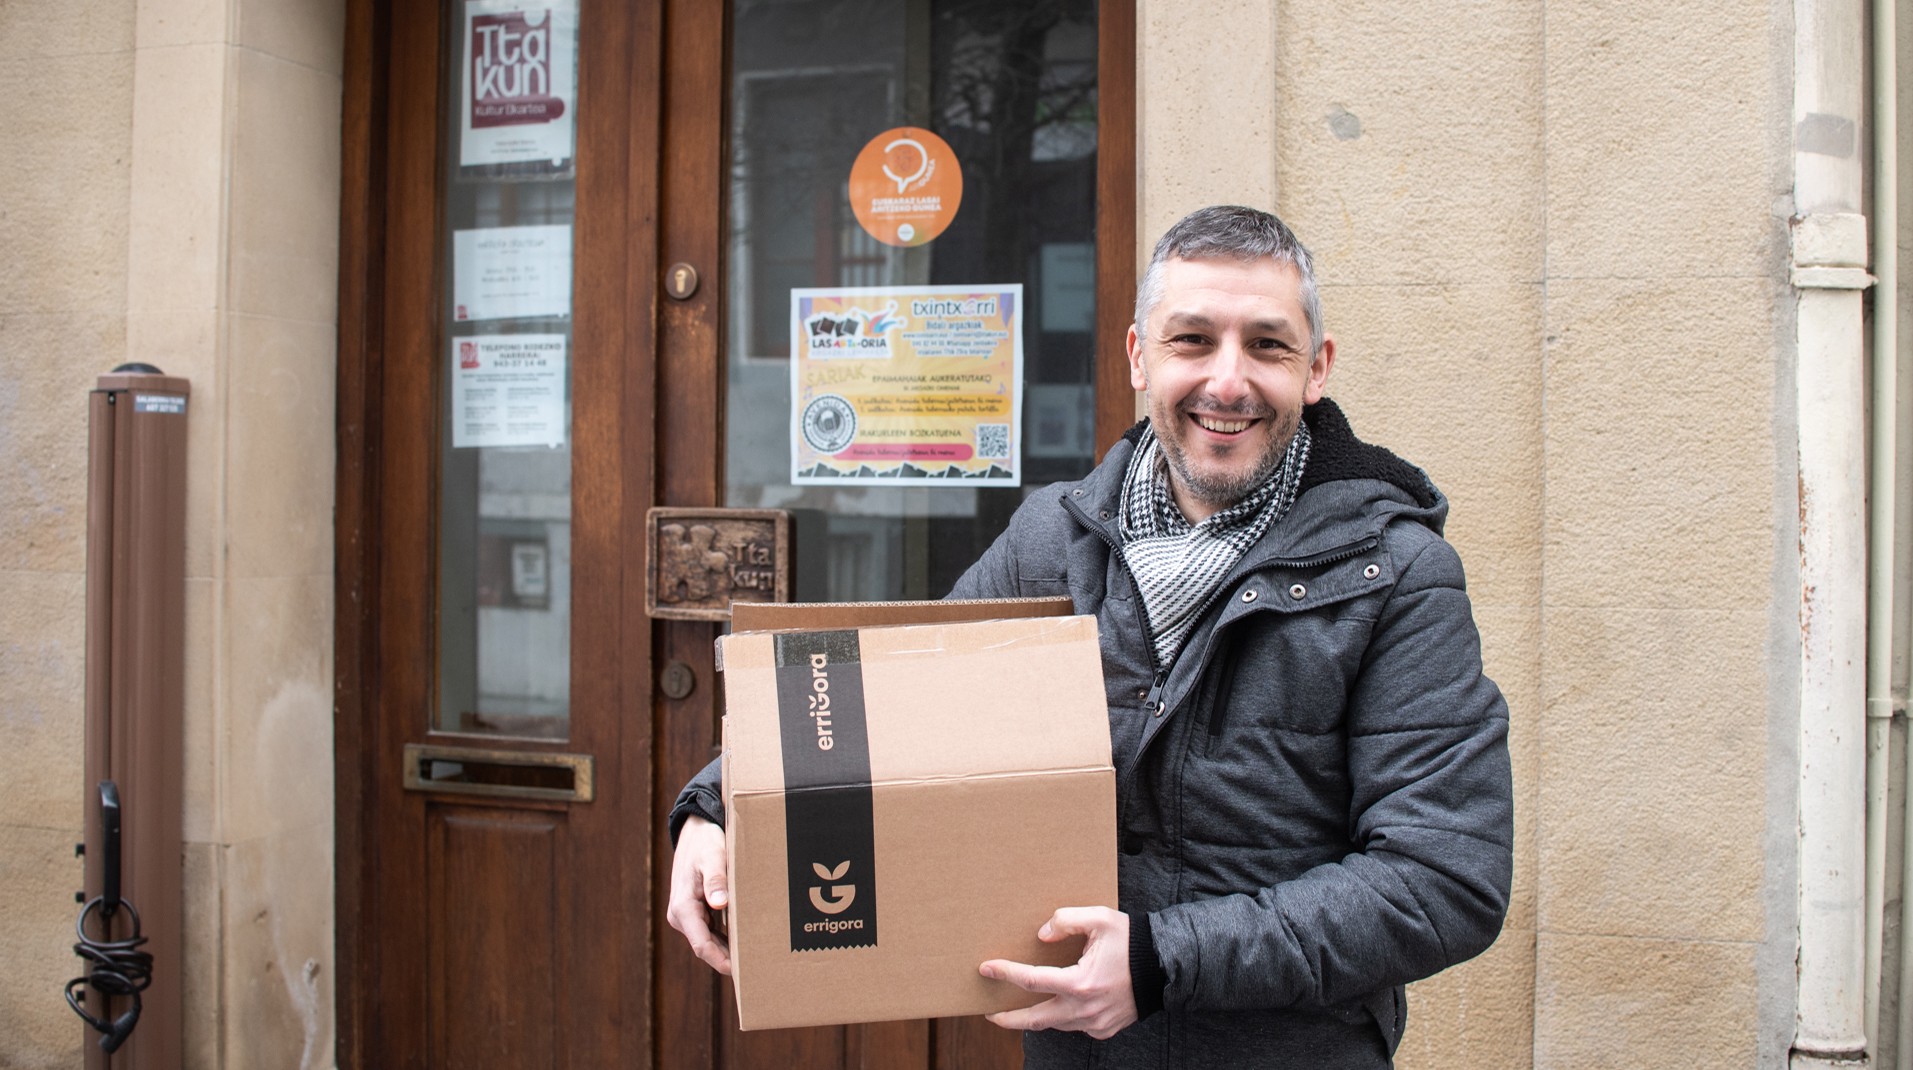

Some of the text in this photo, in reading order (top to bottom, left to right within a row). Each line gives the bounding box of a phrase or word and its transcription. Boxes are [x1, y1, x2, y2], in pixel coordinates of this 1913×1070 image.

[475, 24, 546, 68] Tta
[475, 56, 547, 100] kun
[916, 196, 940, 204] LASAI
[806, 364, 866, 387] SARIAK
[929, 374, 992, 383] AUKERATUTAKO
[804, 918, 864, 934] errigora
